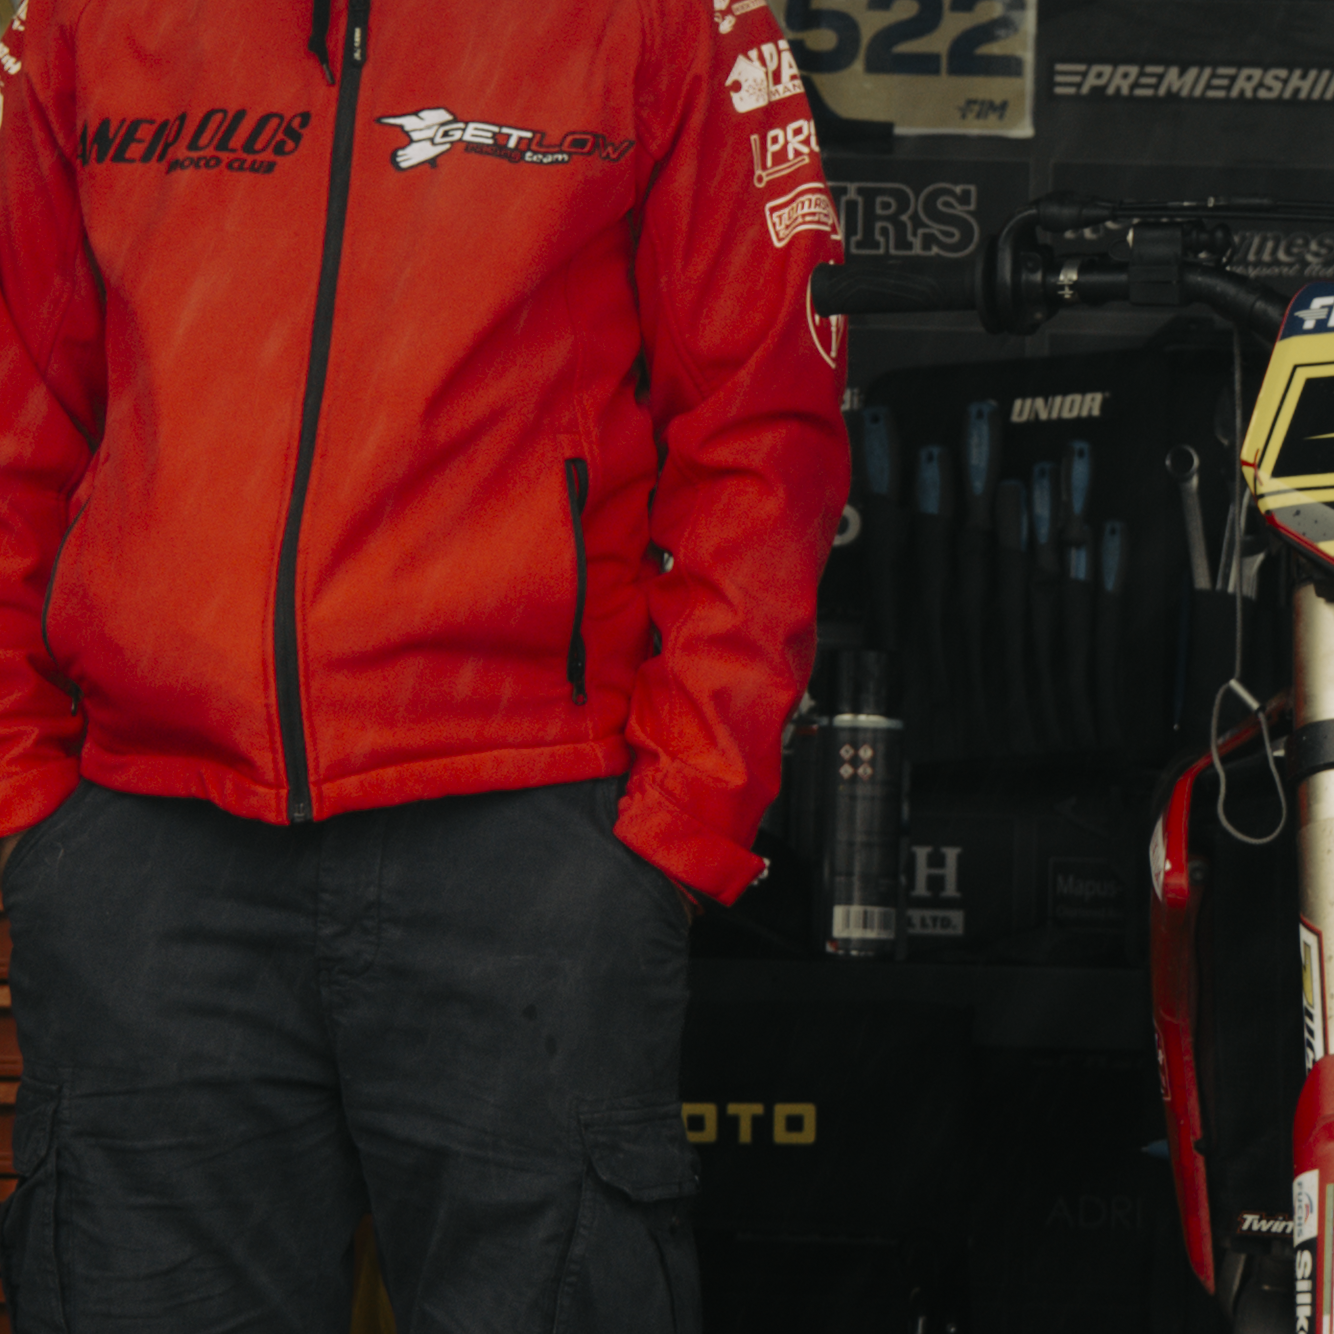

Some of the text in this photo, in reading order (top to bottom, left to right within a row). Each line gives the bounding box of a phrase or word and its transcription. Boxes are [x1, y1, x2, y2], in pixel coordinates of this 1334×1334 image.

[524, 151, 570, 164] team
[1009, 391, 1104, 424] UNIOR
[1238, 1214, 1294, 1234] Twin
